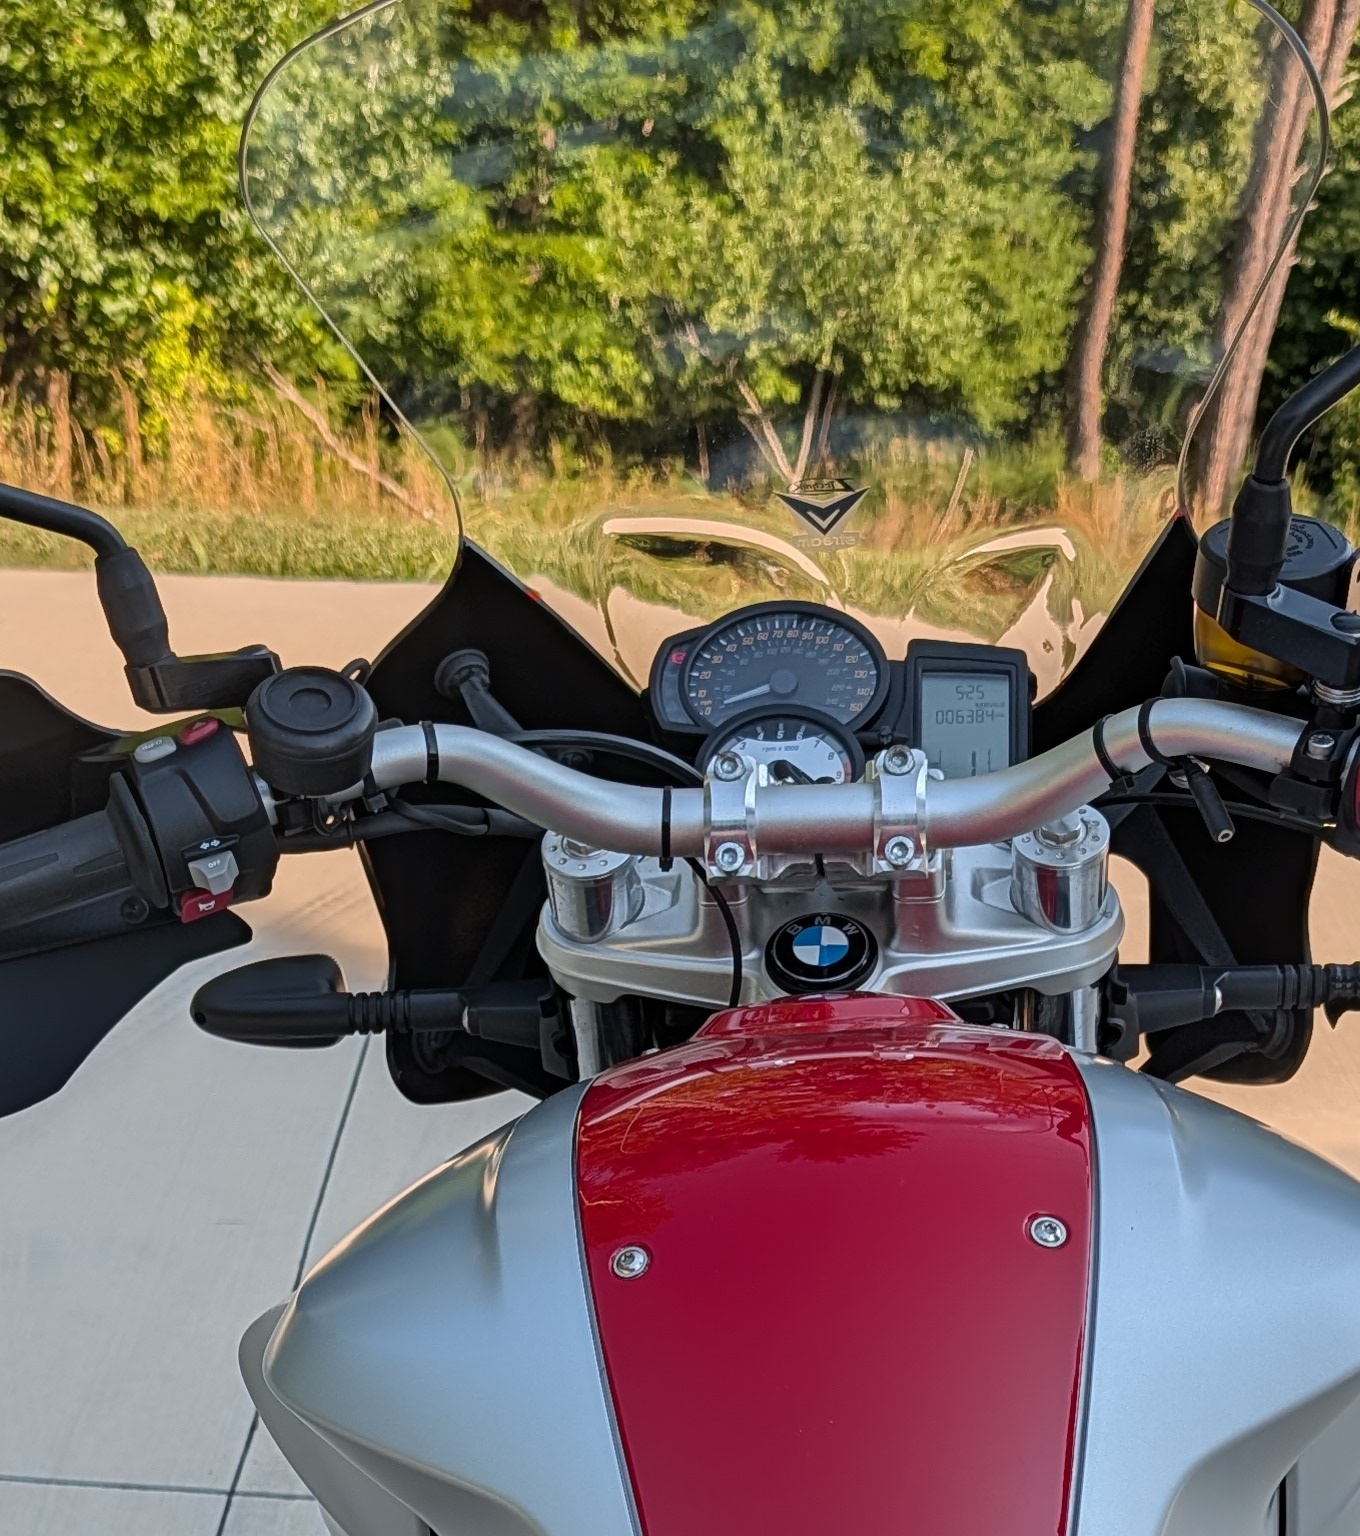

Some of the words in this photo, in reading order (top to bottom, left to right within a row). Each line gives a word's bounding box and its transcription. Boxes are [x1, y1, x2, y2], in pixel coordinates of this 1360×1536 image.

[757, 632, 769, 640] 60
[772, 630, 784, 638] 70
[786, 630, 799, 638] 80
[802, 632, 814, 640] 90
[742, 637, 754, 645] 50
[815, 636, 830, 644] 100
[725, 644, 737, 652] 40
[832, 643, 844, 652] 110
[711, 655, 723, 664] 30
[845, 655, 859, 664] 120
[699, 670, 712, 679] 20
[854, 670, 868, 679] 130
[697, 689, 707, 698] 10
[857, 688, 870, 696] 140
[704, 706, 712, 715] 0
[849, 703, 863, 712] 150
[935, 709, 994, 725] 006384
[758, 732, 765, 740] 4
[777, 730, 785, 739] 5
[796, 732, 804, 741] 6
[739, 742, 746, 751] 3
[813, 740, 820, 748] 7
[827, 752, 835, 761] 8
[835, 771, 842, 780] 9
[208, 859, 221, 868] OFF
[786, 915, 860, 936] BMW
